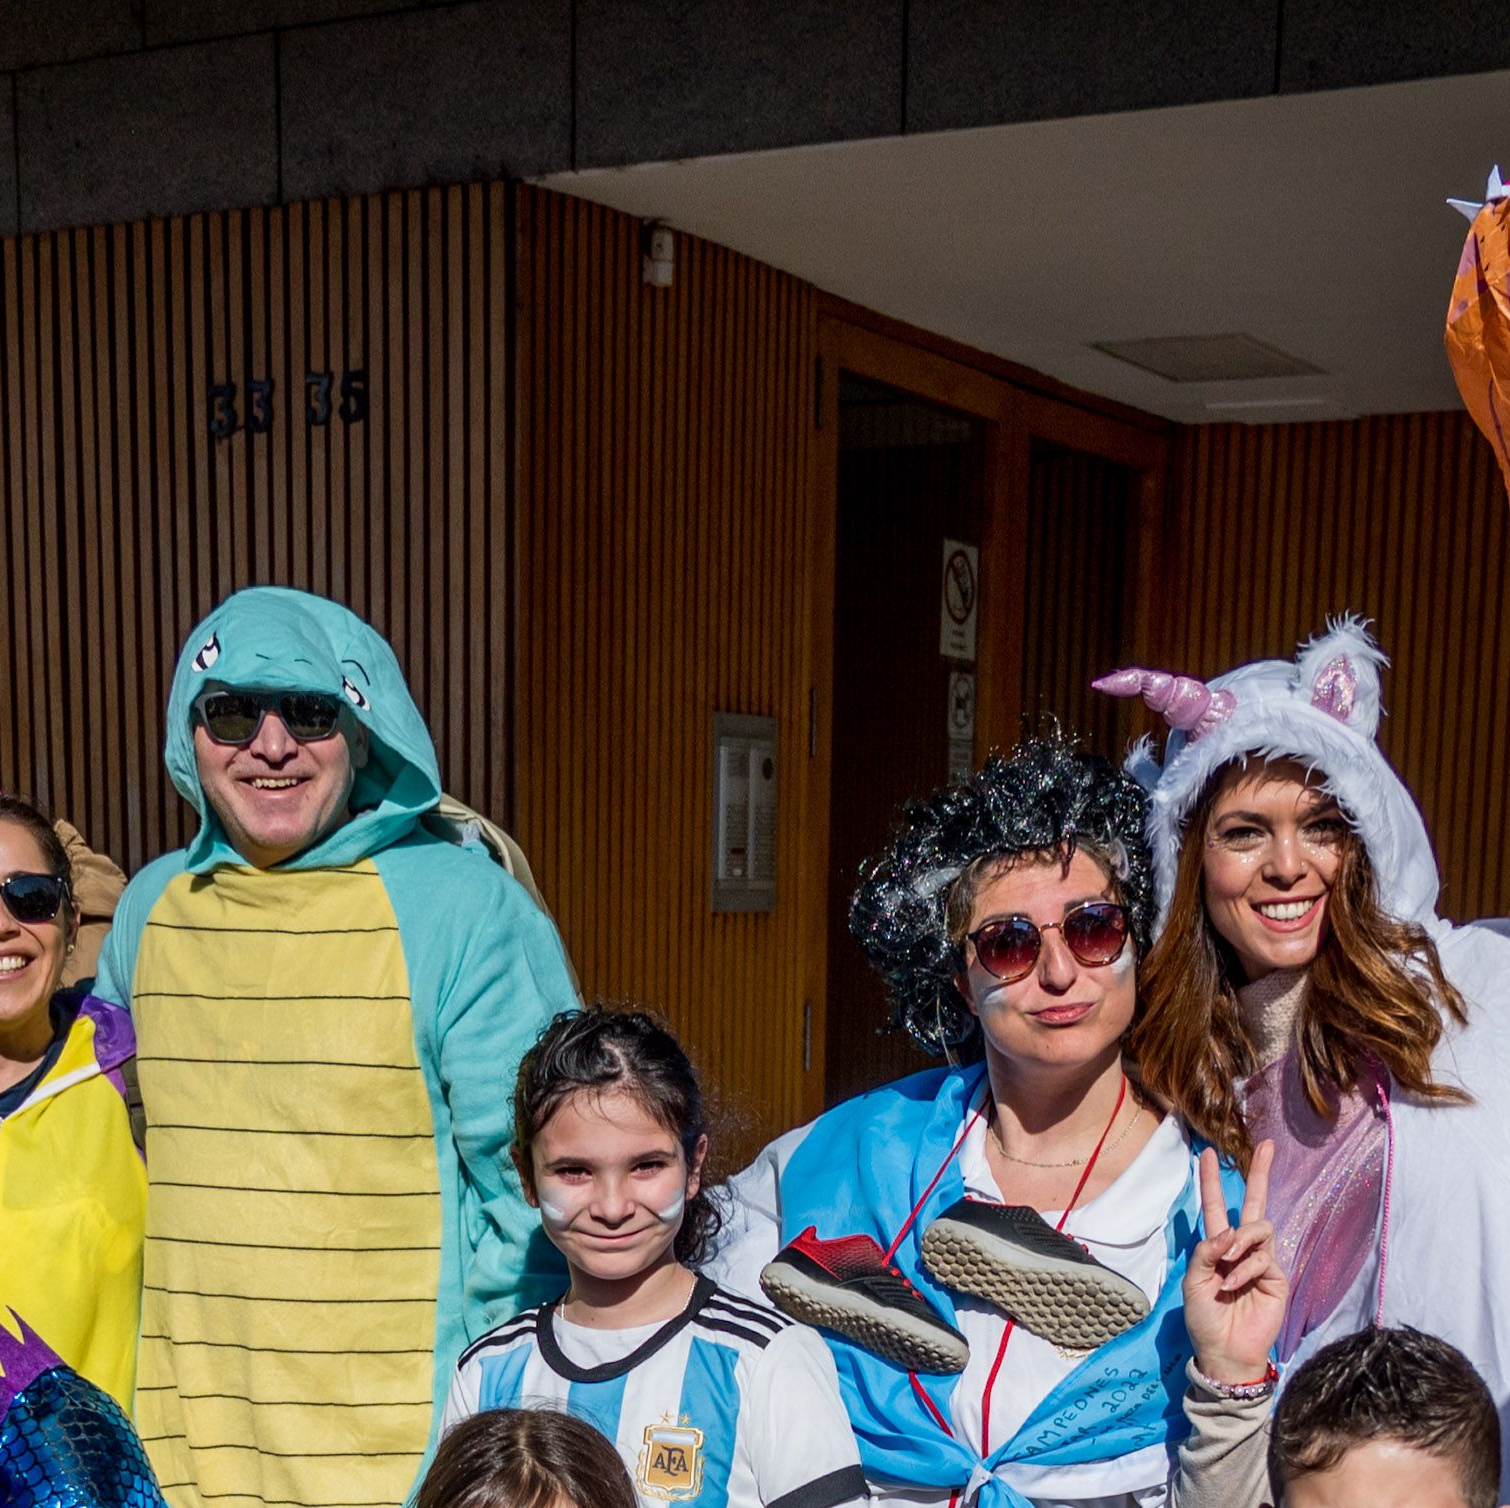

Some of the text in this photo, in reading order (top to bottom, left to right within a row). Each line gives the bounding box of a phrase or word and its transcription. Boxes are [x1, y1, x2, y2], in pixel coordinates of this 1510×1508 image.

[208, 369, 367, 440] 33 35
[1100, 1367, 1149, 1415] 2022
[652, 1444, 689, 1477] AFA
